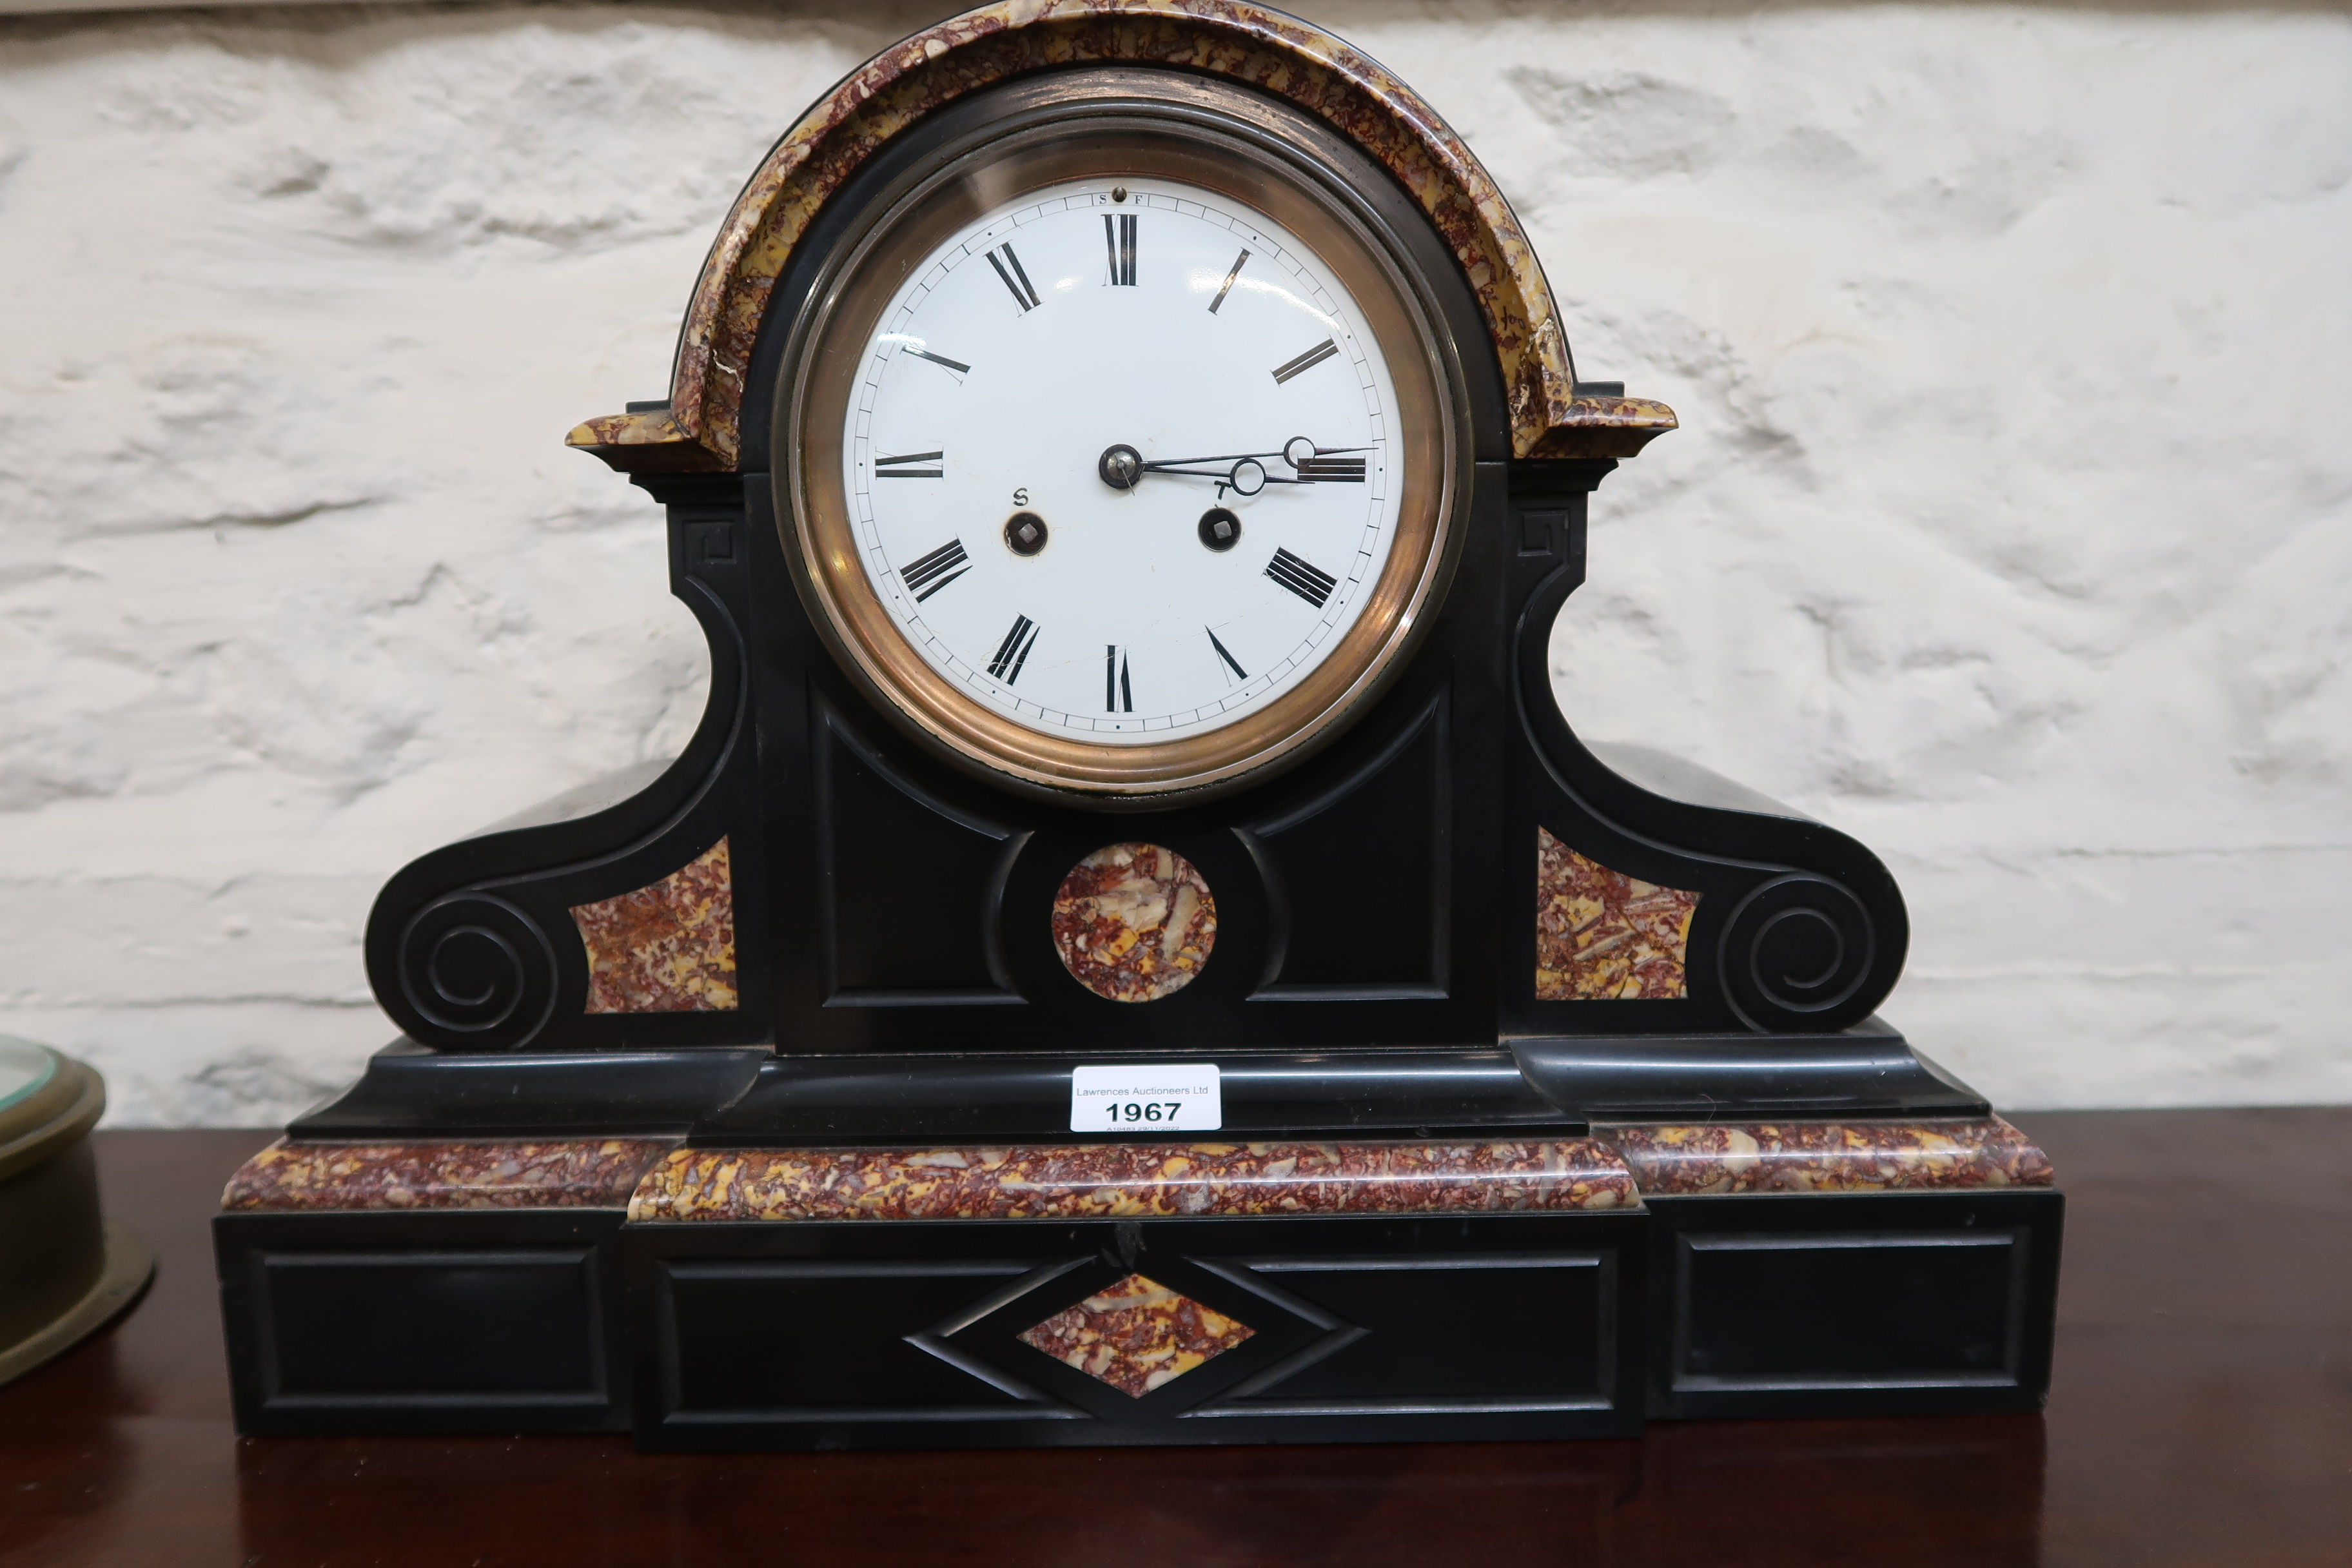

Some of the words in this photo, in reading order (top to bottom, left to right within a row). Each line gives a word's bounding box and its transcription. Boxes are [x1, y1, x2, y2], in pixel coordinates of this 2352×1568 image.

[1099, 195, 1106, 204] S
[1135, 195, 1142, 204] F
[983, 239, 1044, 318] XI
[1101, 213, 1139, 286] XII
[1208, 247, 1253, 315] I
[1269, 335, 1341, 389] II
[875, 446, 944, 481] IX
[1297, 455, 1366, 487] III
[1013, 487, 1029, 506] S
[897, 533, 974, 606] VIII
[1260, 545, 1338, 612] IIII
[986, 611, 1041, 687] VII
[1204, 624, 1251, 688] V
[1104, 645, 1137, 713] VI
[1106, 1103, 1182, 1122] 1967
[1133, 1087, 1190, 1095] Auctioneers
